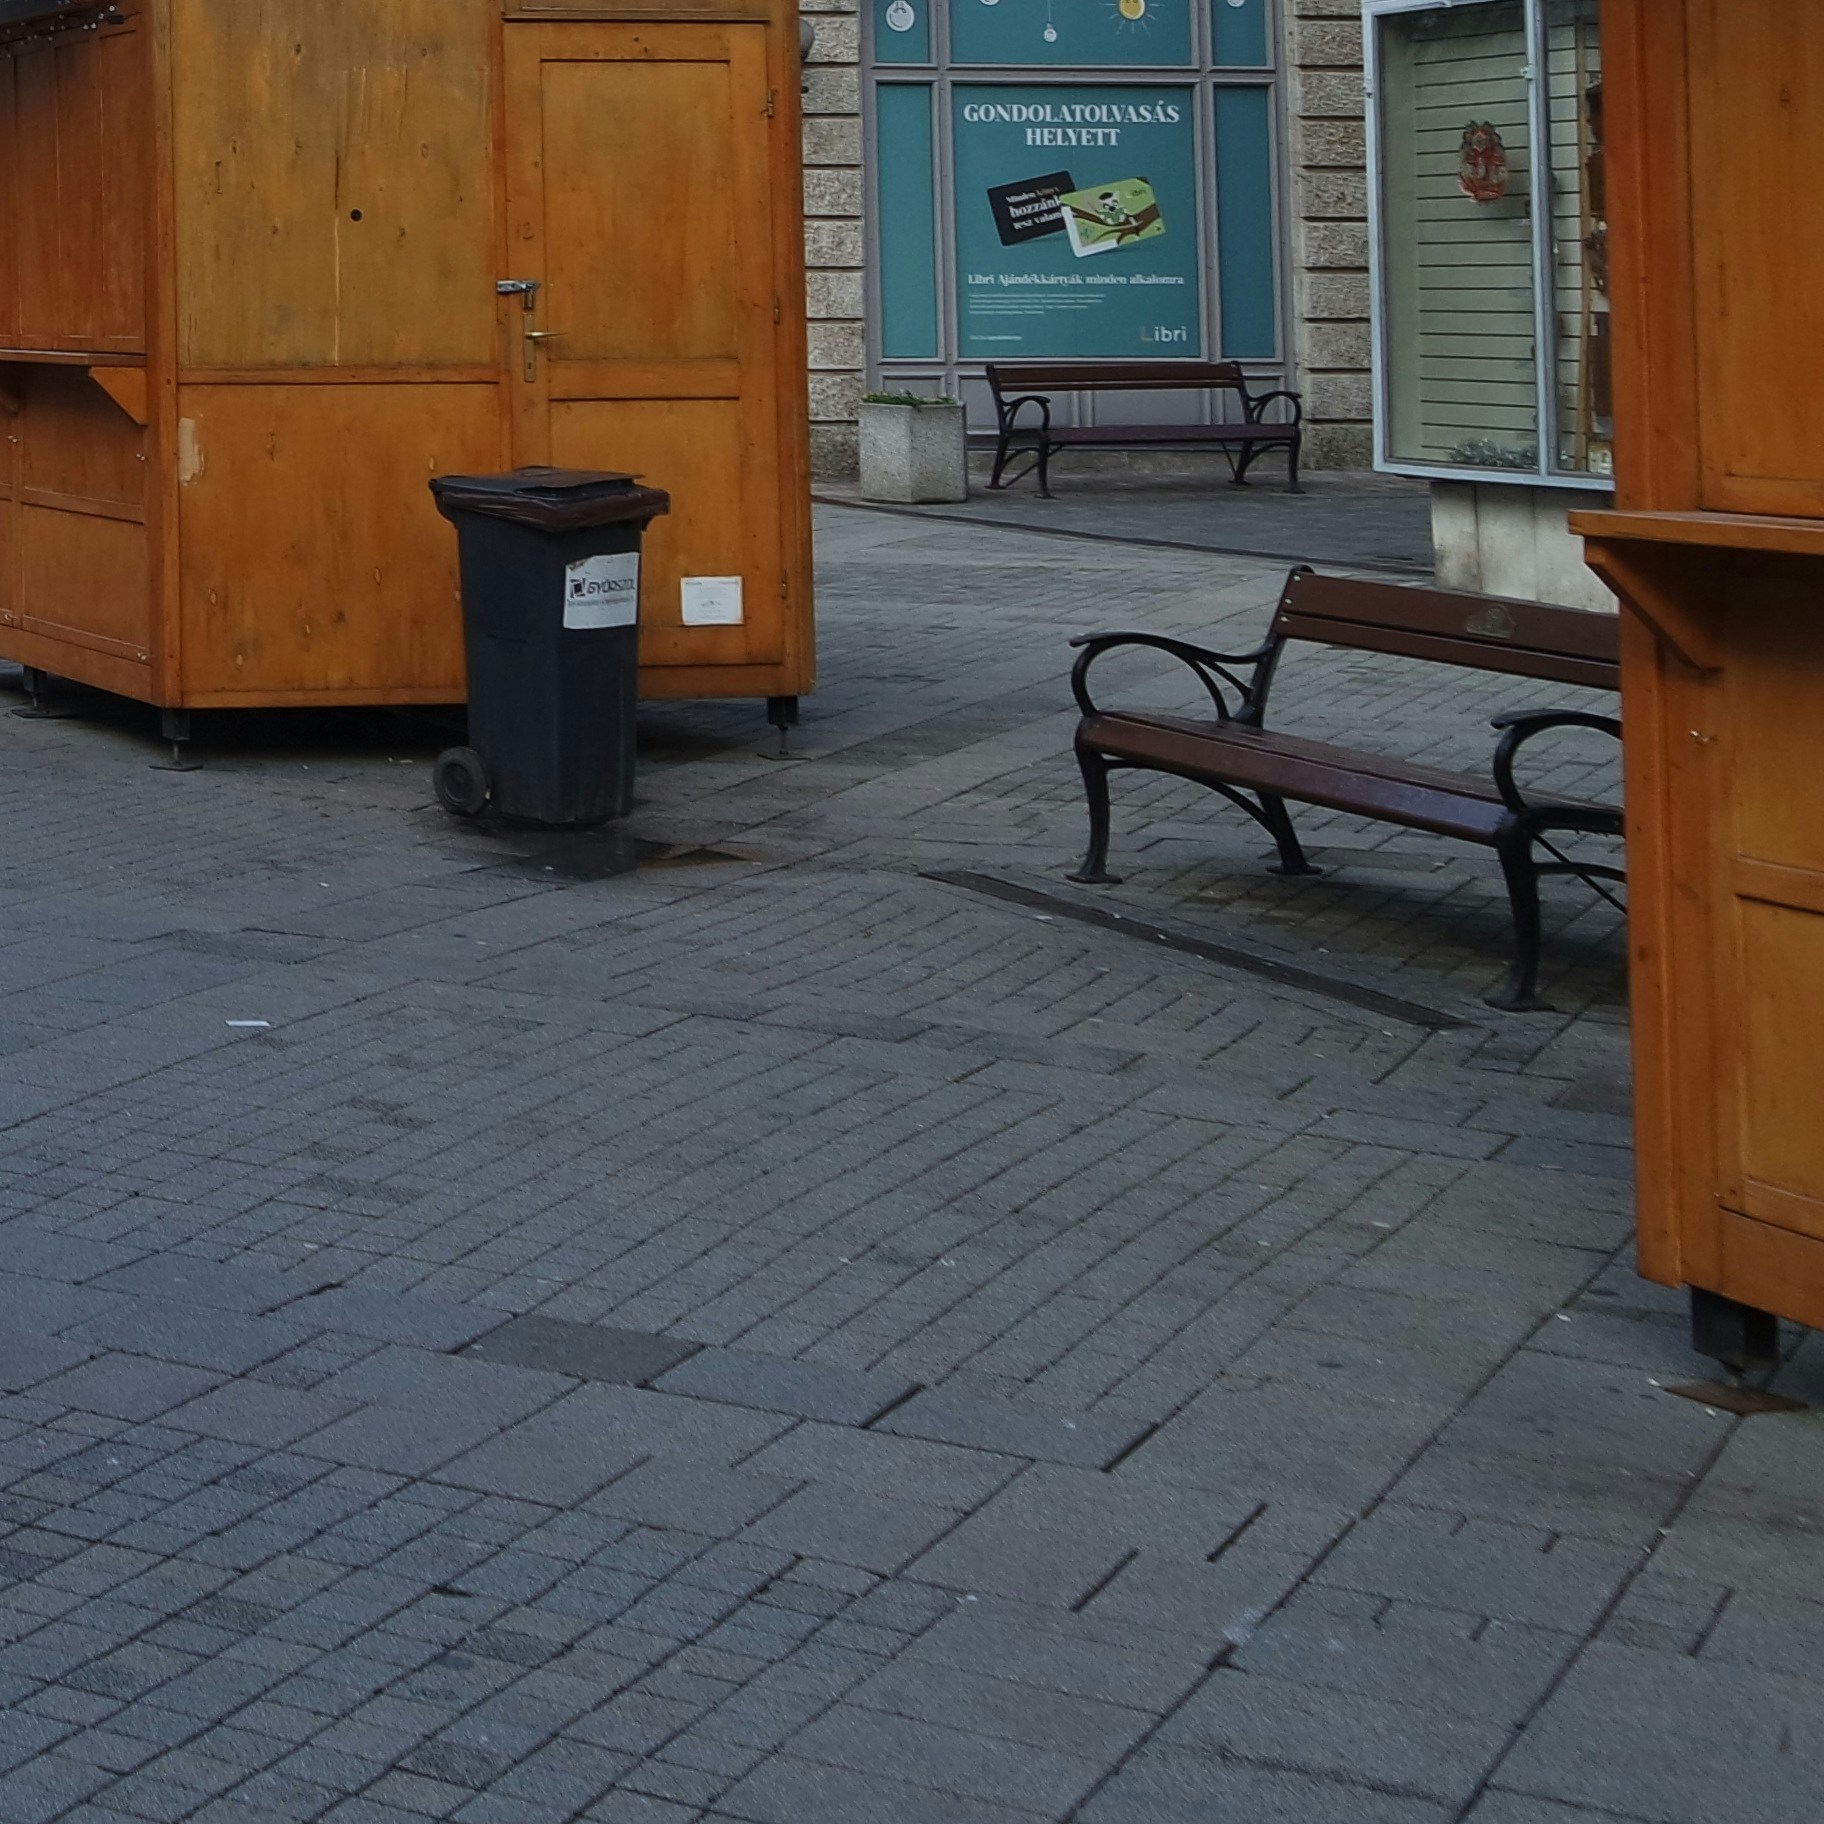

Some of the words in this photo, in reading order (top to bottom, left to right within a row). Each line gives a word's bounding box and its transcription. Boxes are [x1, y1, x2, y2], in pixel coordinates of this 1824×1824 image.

[963, 100, 1180, 123] GONDOLATOLVASÁS
[1025, 128, 1121, 146] HELYETT
[968, 274, 995, 284] Libri
[1085, 275, 1127, 284] minden
[1130, 275, 1185, 285] alkalomra
[1140, 326, 1187, 342] Libri
